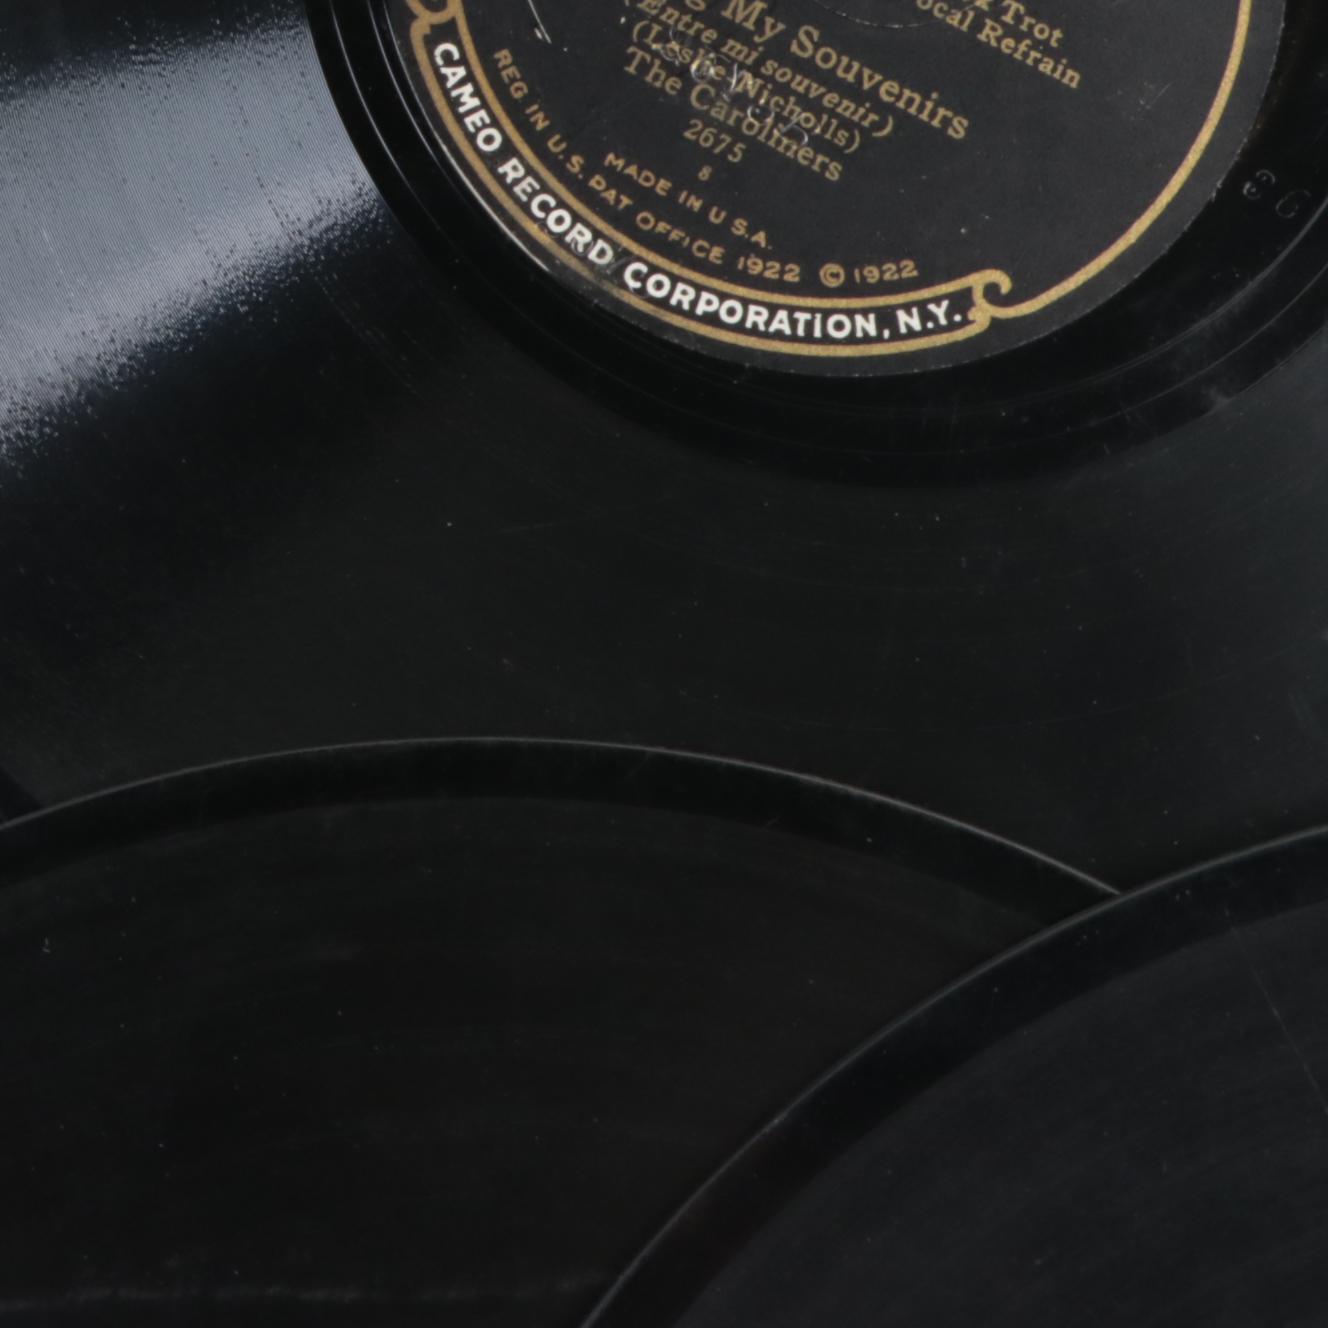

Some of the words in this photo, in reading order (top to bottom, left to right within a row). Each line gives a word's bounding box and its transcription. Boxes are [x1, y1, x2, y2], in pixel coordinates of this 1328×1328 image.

[624, 45, 684, 96] The
[720, 40, 765, 66] mi
[760, 59, 894, 138] souvenir)
[788, 24, 970, 141] Souvenirs
[976, 18, 1082, 90] Refrain
[682, 119, 747, 163] 2675
[735, 69, 862, 155] Nicholls)
[432, 41, 503, 153] CAMEO
[497, 156, 615, 266] RECORD
[623, 261, 891, 340] CORPORATION,
[896, 298, 963, 335] N.Y.
[493, 48, 529, 100] REG
[525, 103, 551, 132] IN
[587, 173, 634, 211] PAT
[635, 210, 726, 265] OFFICE
[736, 254, 802, 284] 1922
[853, 258, 920, 285] 1922
[604, 151, 673, 196] MADE
[678, 190, 704, 213] IN
[697, 164, 713, 182] 8
